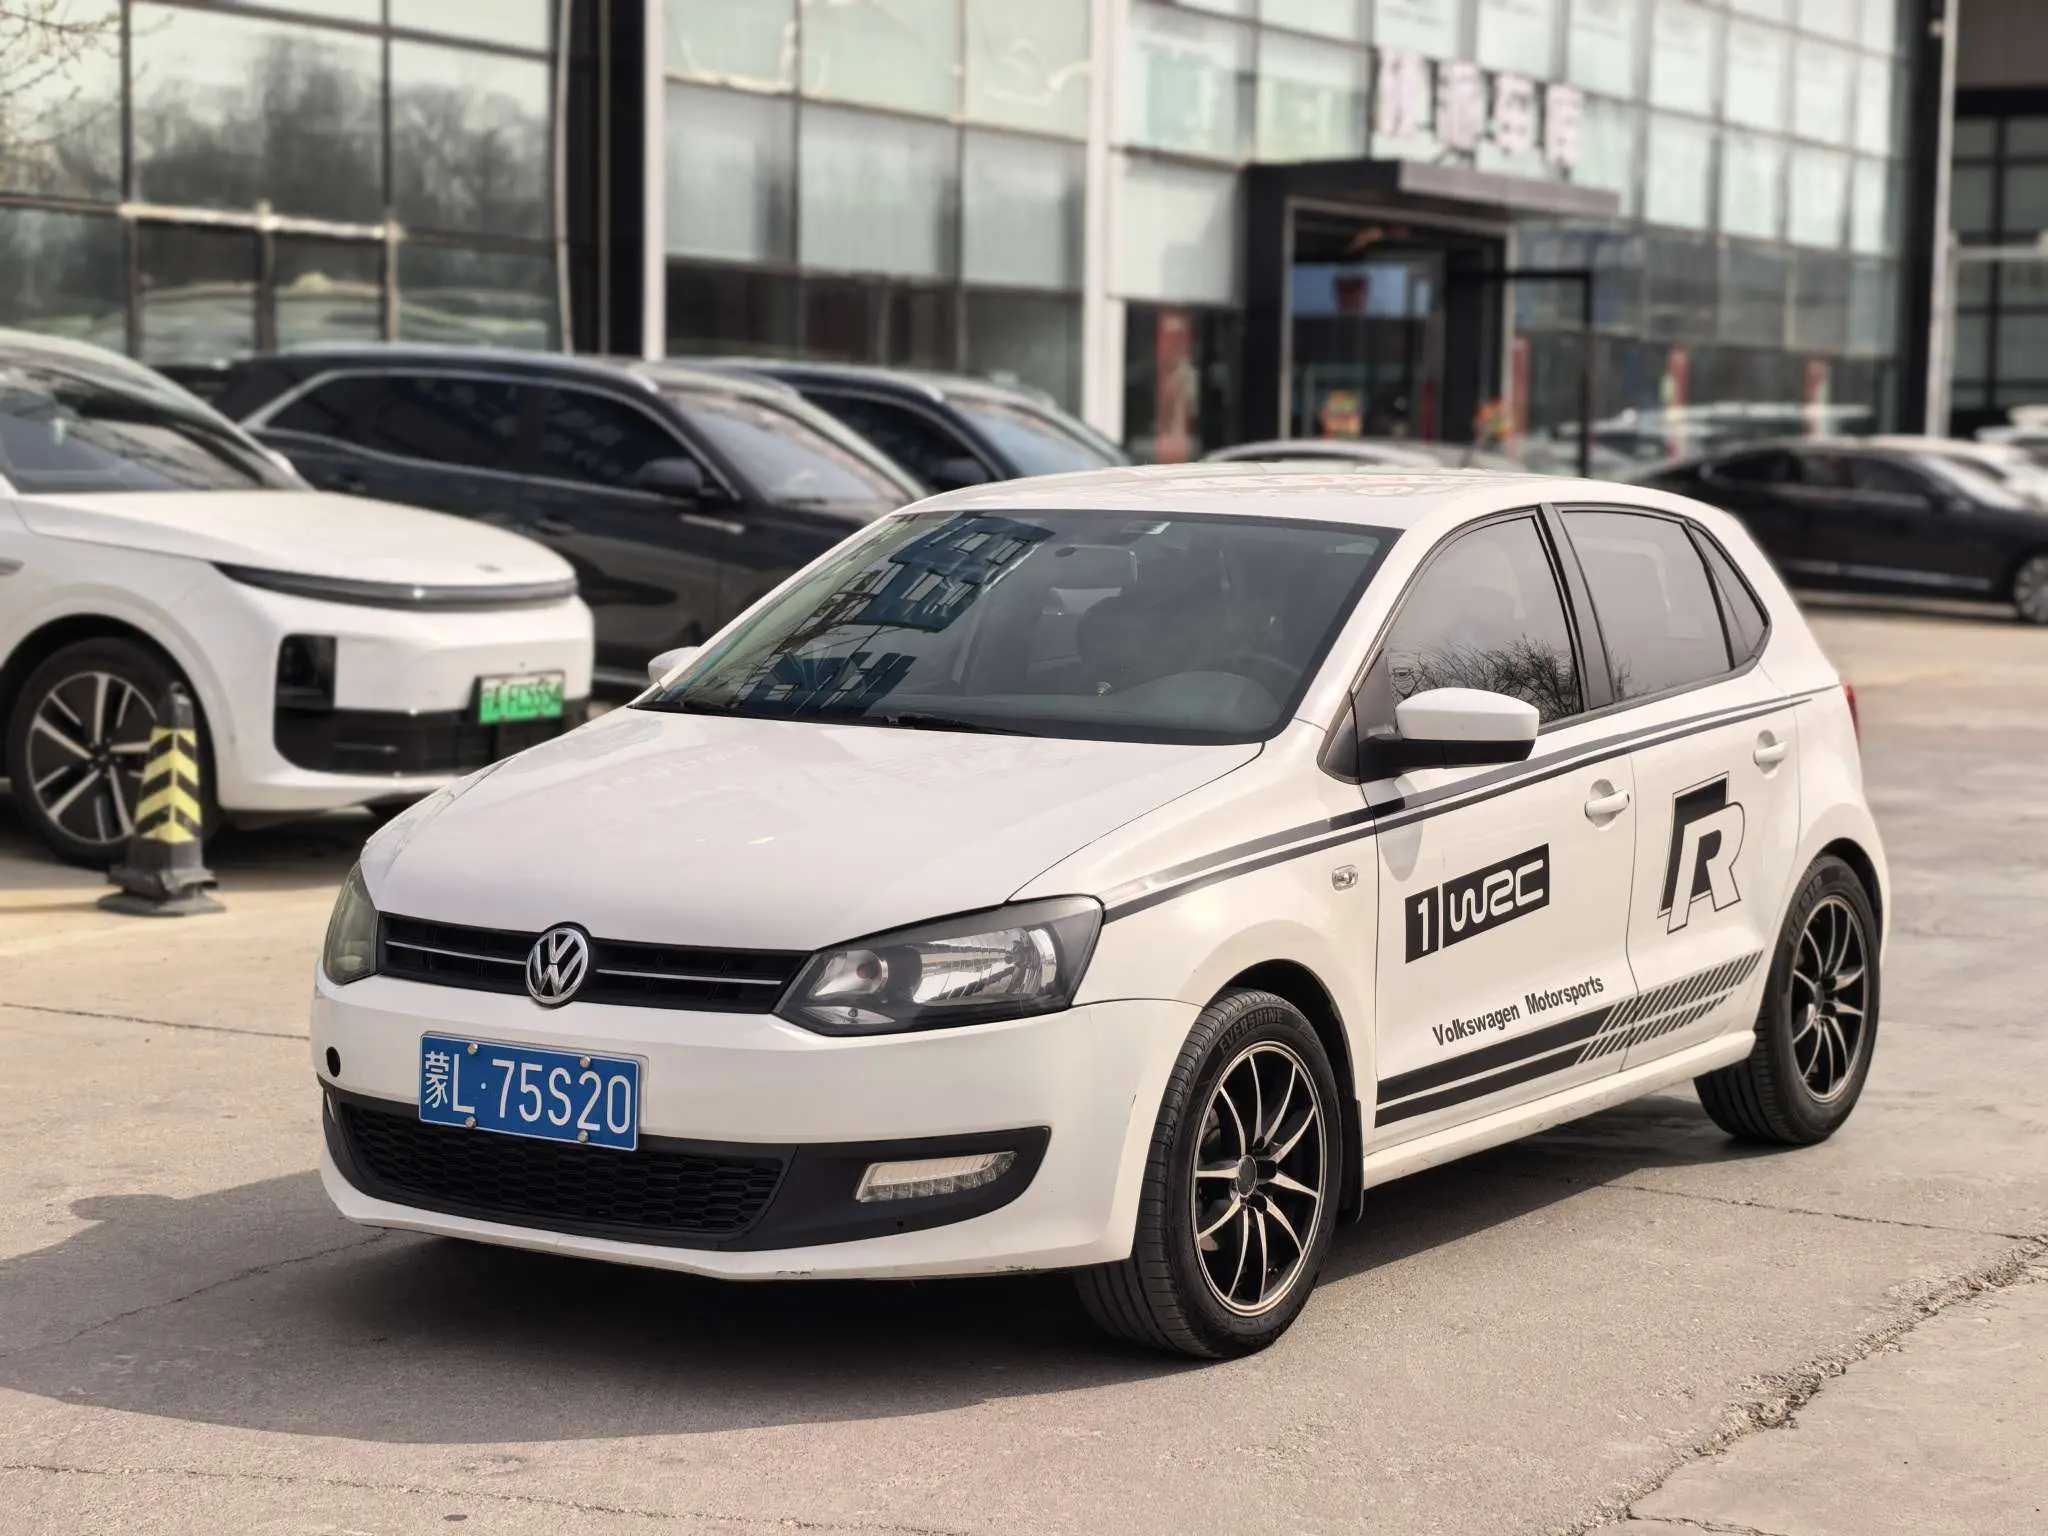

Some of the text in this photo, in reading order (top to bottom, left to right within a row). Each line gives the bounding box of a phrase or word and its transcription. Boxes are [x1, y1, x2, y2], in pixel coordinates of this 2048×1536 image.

[1417, 859, 1545, 952] 1 WRC
[1666, 800, 1746, 935] R
[1432, 975, 1605, 1046] Volkswagen Motorsports
